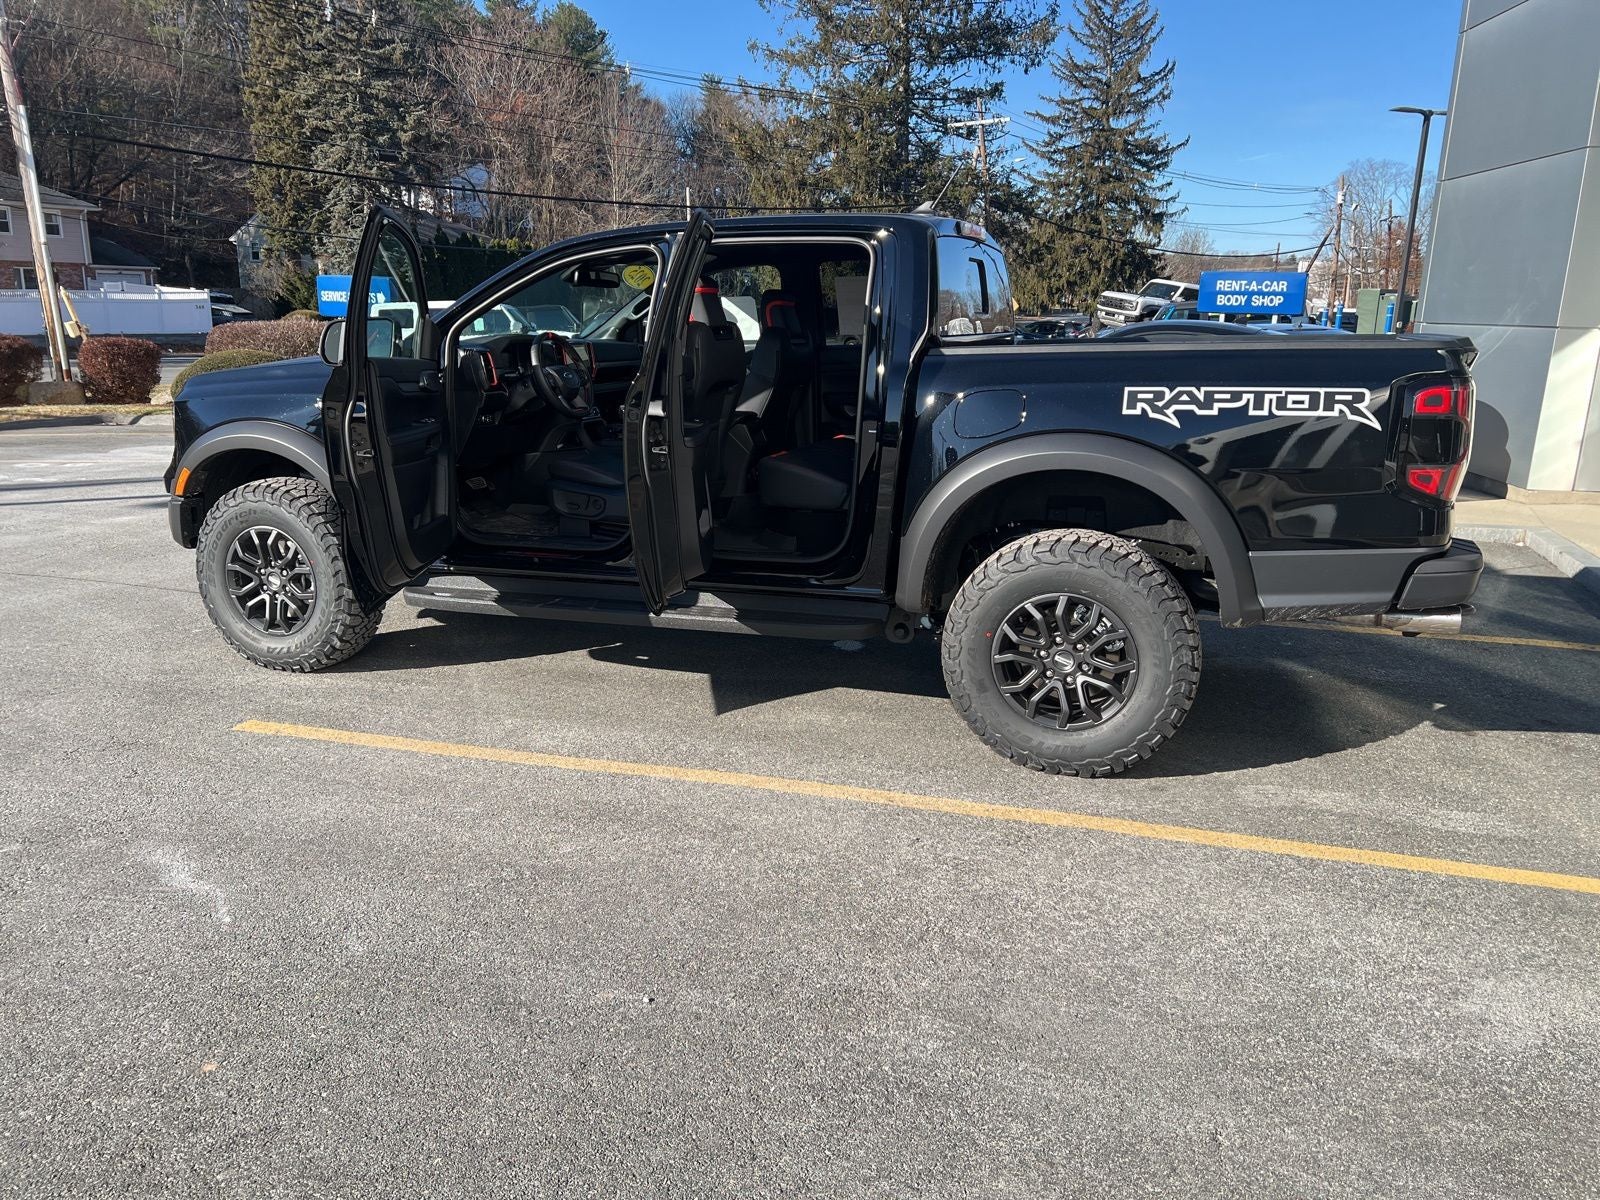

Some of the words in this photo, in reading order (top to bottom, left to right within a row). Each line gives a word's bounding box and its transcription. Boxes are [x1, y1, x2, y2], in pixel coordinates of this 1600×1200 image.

[1216, 280, 1288, 292] RENT-A-CAR
[320, 290, 348, 302] SERVICE
[1216, 294, 1248, 306] BODY
[1251, 295, 1284, 307] SHOP
[1122, 386, 1382, 432] RAPTOR
